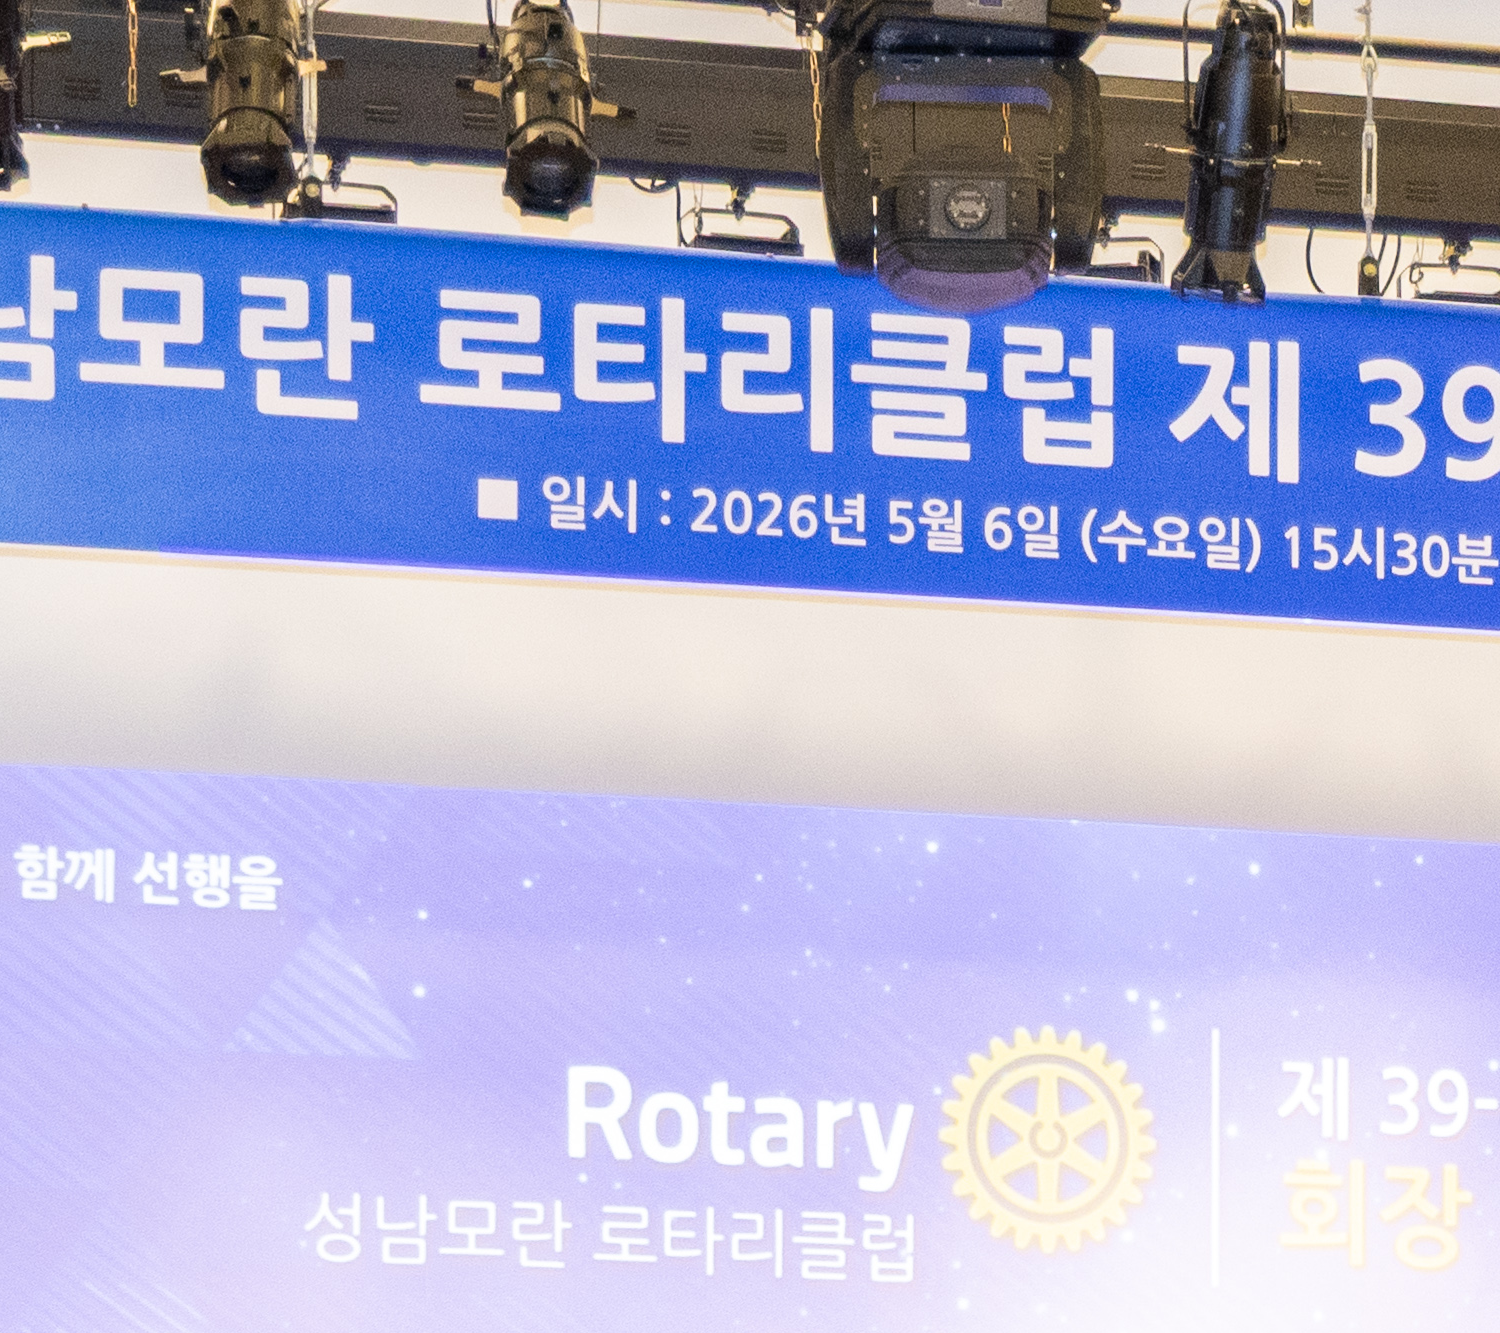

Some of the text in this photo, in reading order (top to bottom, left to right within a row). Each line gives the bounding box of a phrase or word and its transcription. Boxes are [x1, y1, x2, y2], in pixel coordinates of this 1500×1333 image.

[419, 289, 1112, 471] 로타리클럽
[1169, 340, 1299, 484] 제
[542, 476, 637, 533] 일시
[691, 487, 866, 546] 2026년
[889, 498, 963, 553] 5월
[984, 505, 1059, 559] 6일
[1081, 508, 1261, 572] (수요일)
[1285, 526, 1499, 585] 15시30분
[14, 844, 114, 904] 함께
[133, 851, 283, 911] 선행을
[565, 1064, 914, 1193] Rotary
[1278, 1056, 1350, 1143] 제
[302, 1193, 916, 1283] 성남모란 로타리클럽
[1279, 1158, 1472, 1274] 회장
